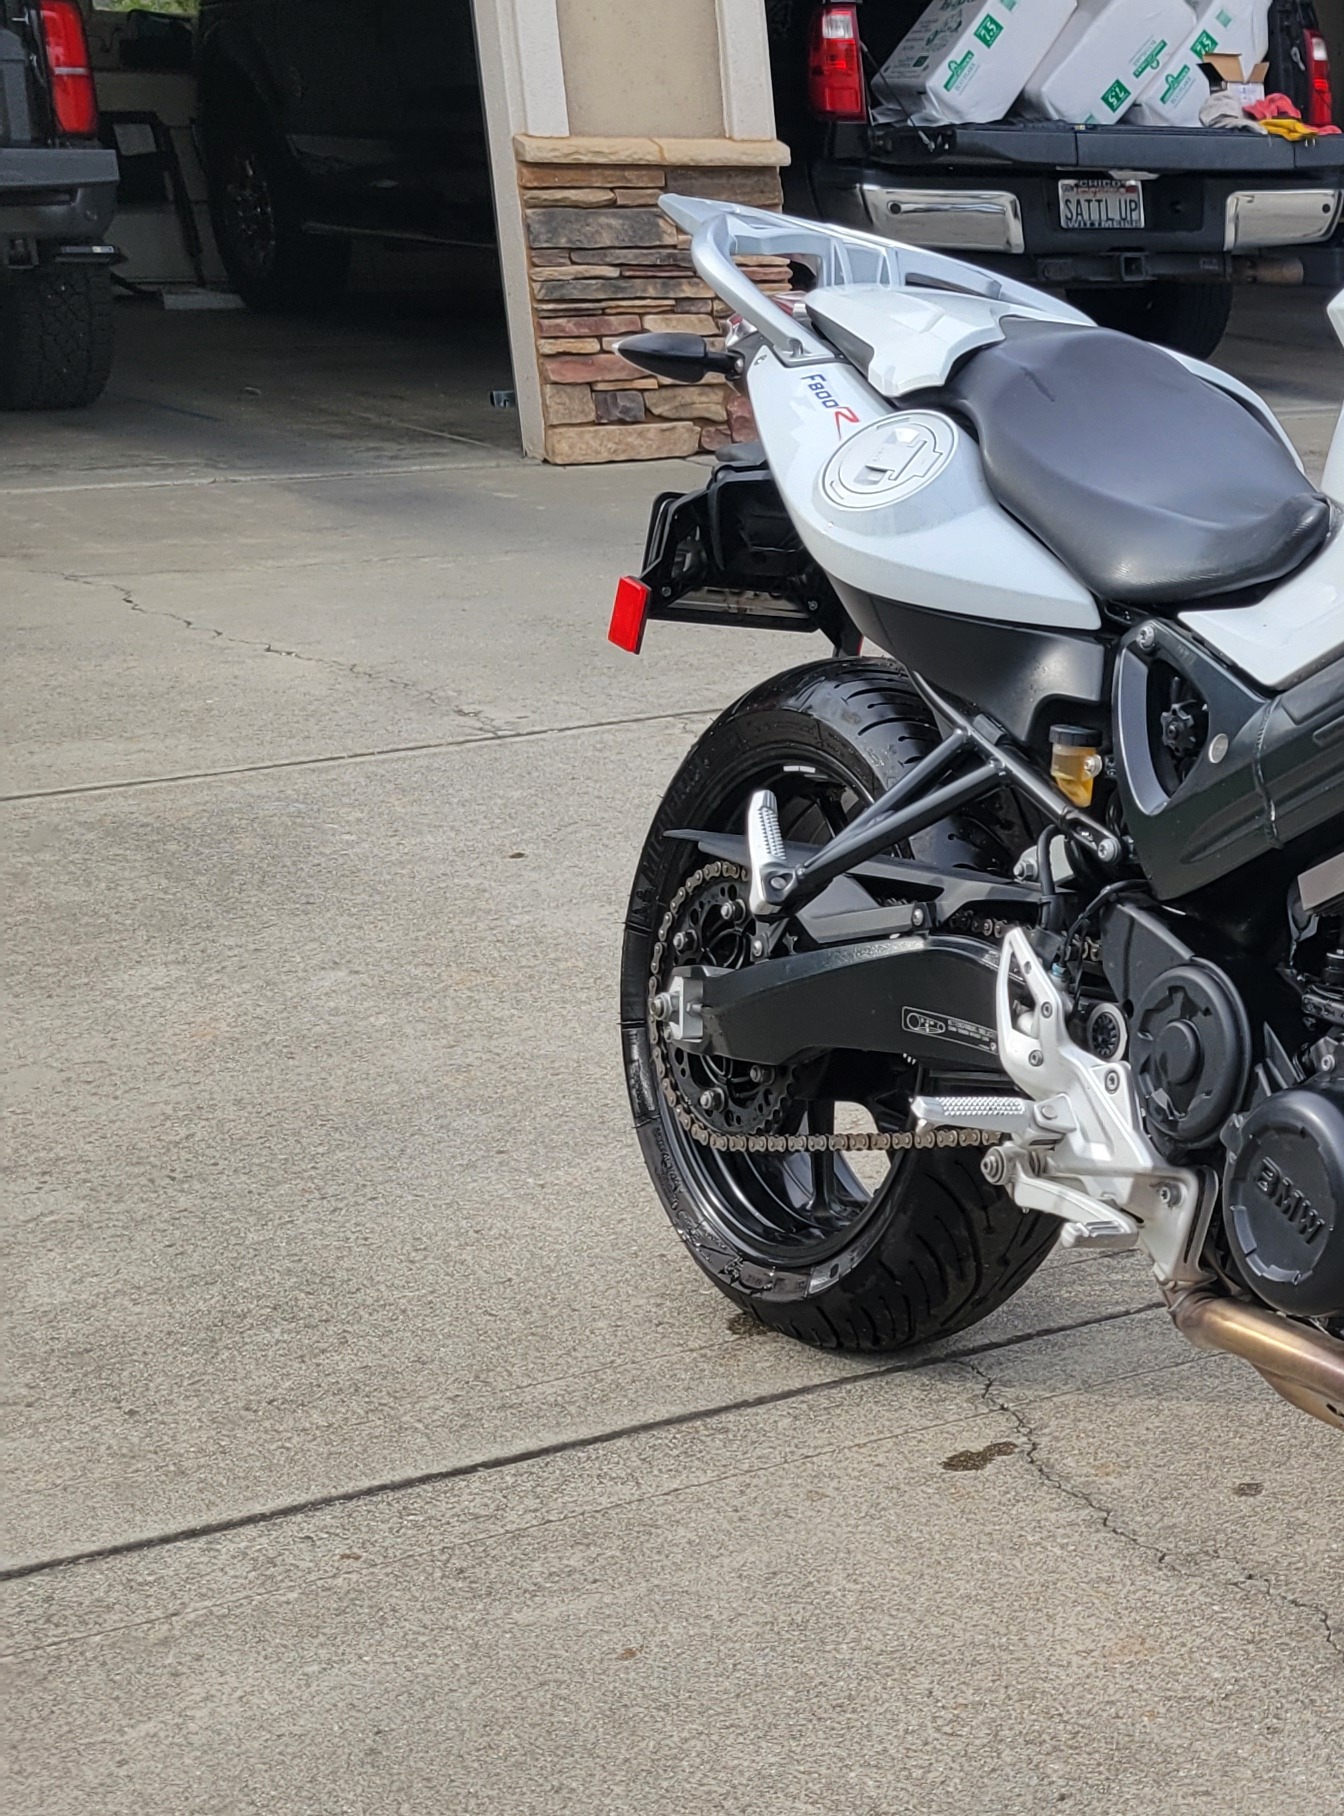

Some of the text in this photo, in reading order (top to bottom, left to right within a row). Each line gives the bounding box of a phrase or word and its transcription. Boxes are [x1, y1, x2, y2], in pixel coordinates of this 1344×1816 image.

[980, 19, 998, 42] 7.5
[1079, 180, 1121, 188] CHICO
[801, 374, 860, 441] F800R
[1254, 1156, 1325, 1245] BMW
